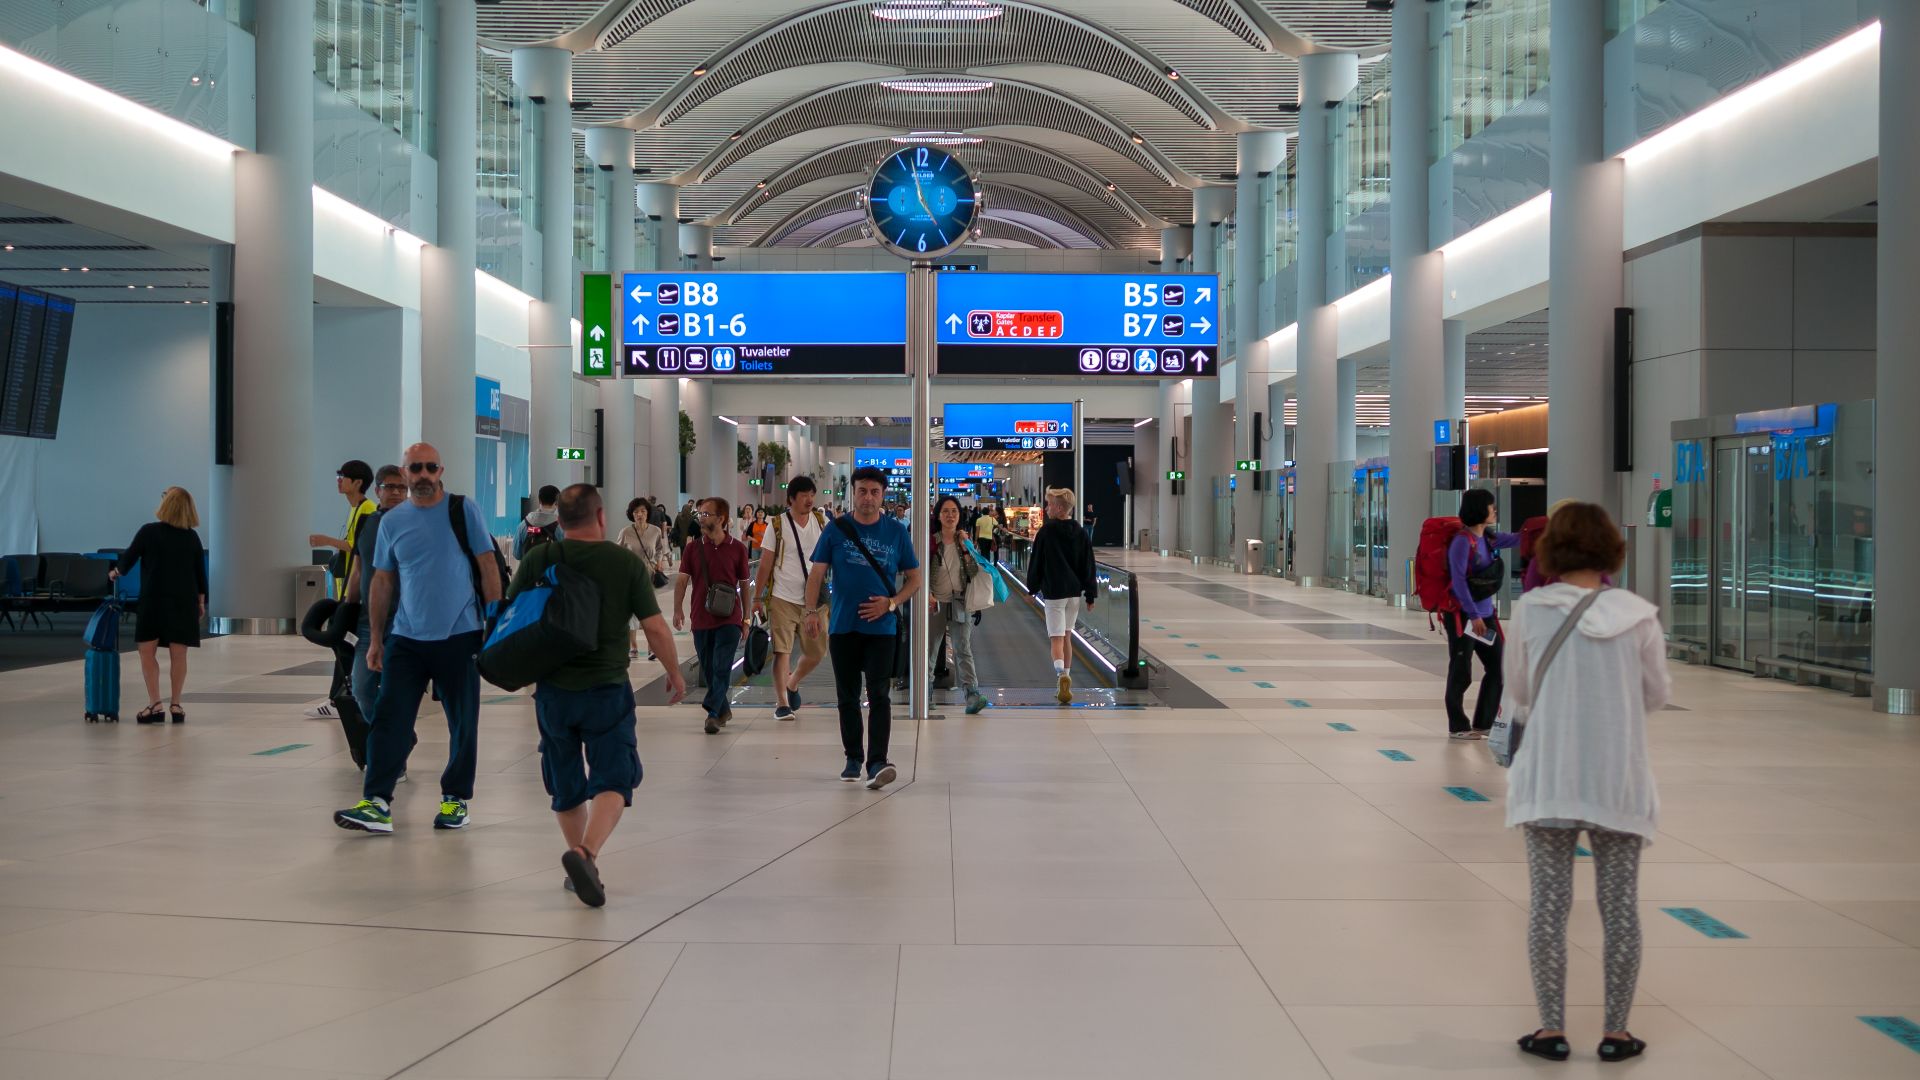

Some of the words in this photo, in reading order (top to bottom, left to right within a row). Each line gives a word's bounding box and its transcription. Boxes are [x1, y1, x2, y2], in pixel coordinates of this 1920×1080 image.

[917, 147, 928, 167] 12
[918, 233, 926, 252] 6
[684, 281, 719, 306] B8
[1124, 282, 1158, 307] B5
[684, 313, 747, 337] B1-6
[1018, 312, 1056, 322] Transfer
[1124, 313, 1158, 337] B7
[996, 326, 1004, 336] A
[1010, 326, 1018, 336] C
[1023, 326, 1032, 336] D
[1037, 326, 1044, 336] E
[1050, 326, 1057, 336] F
[739, 346, 790, 357] Tuvaletler
[740, 360, 773, 370] Toilets
